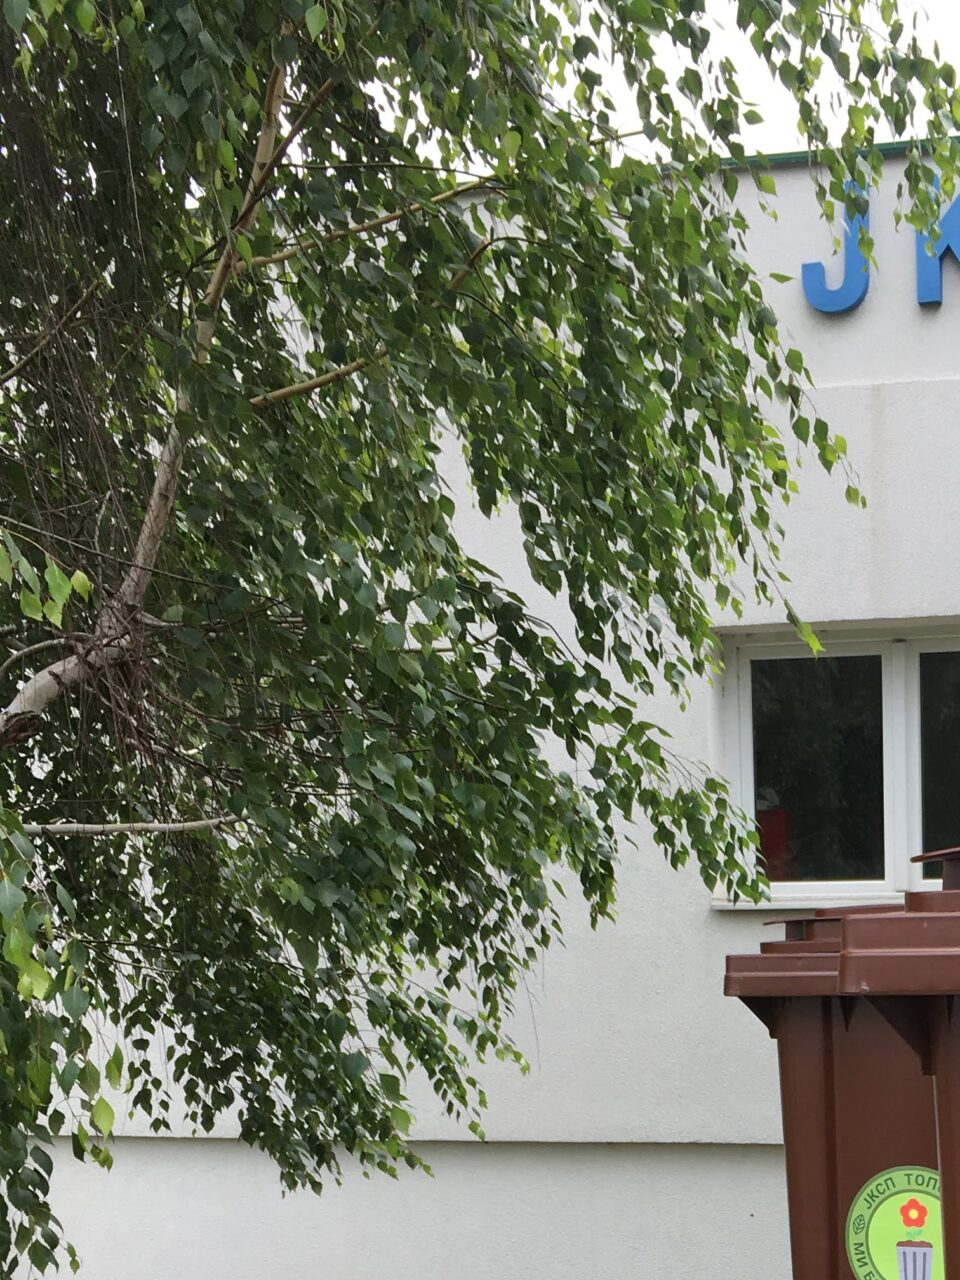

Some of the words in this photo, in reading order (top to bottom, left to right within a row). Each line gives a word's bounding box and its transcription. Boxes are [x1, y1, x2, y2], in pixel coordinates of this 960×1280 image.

[863, 1176, 897, 1210] ЈКСП
[904, 1173, 941, 1192] ТОП
[853, 1242, 869, 1268] МИ
